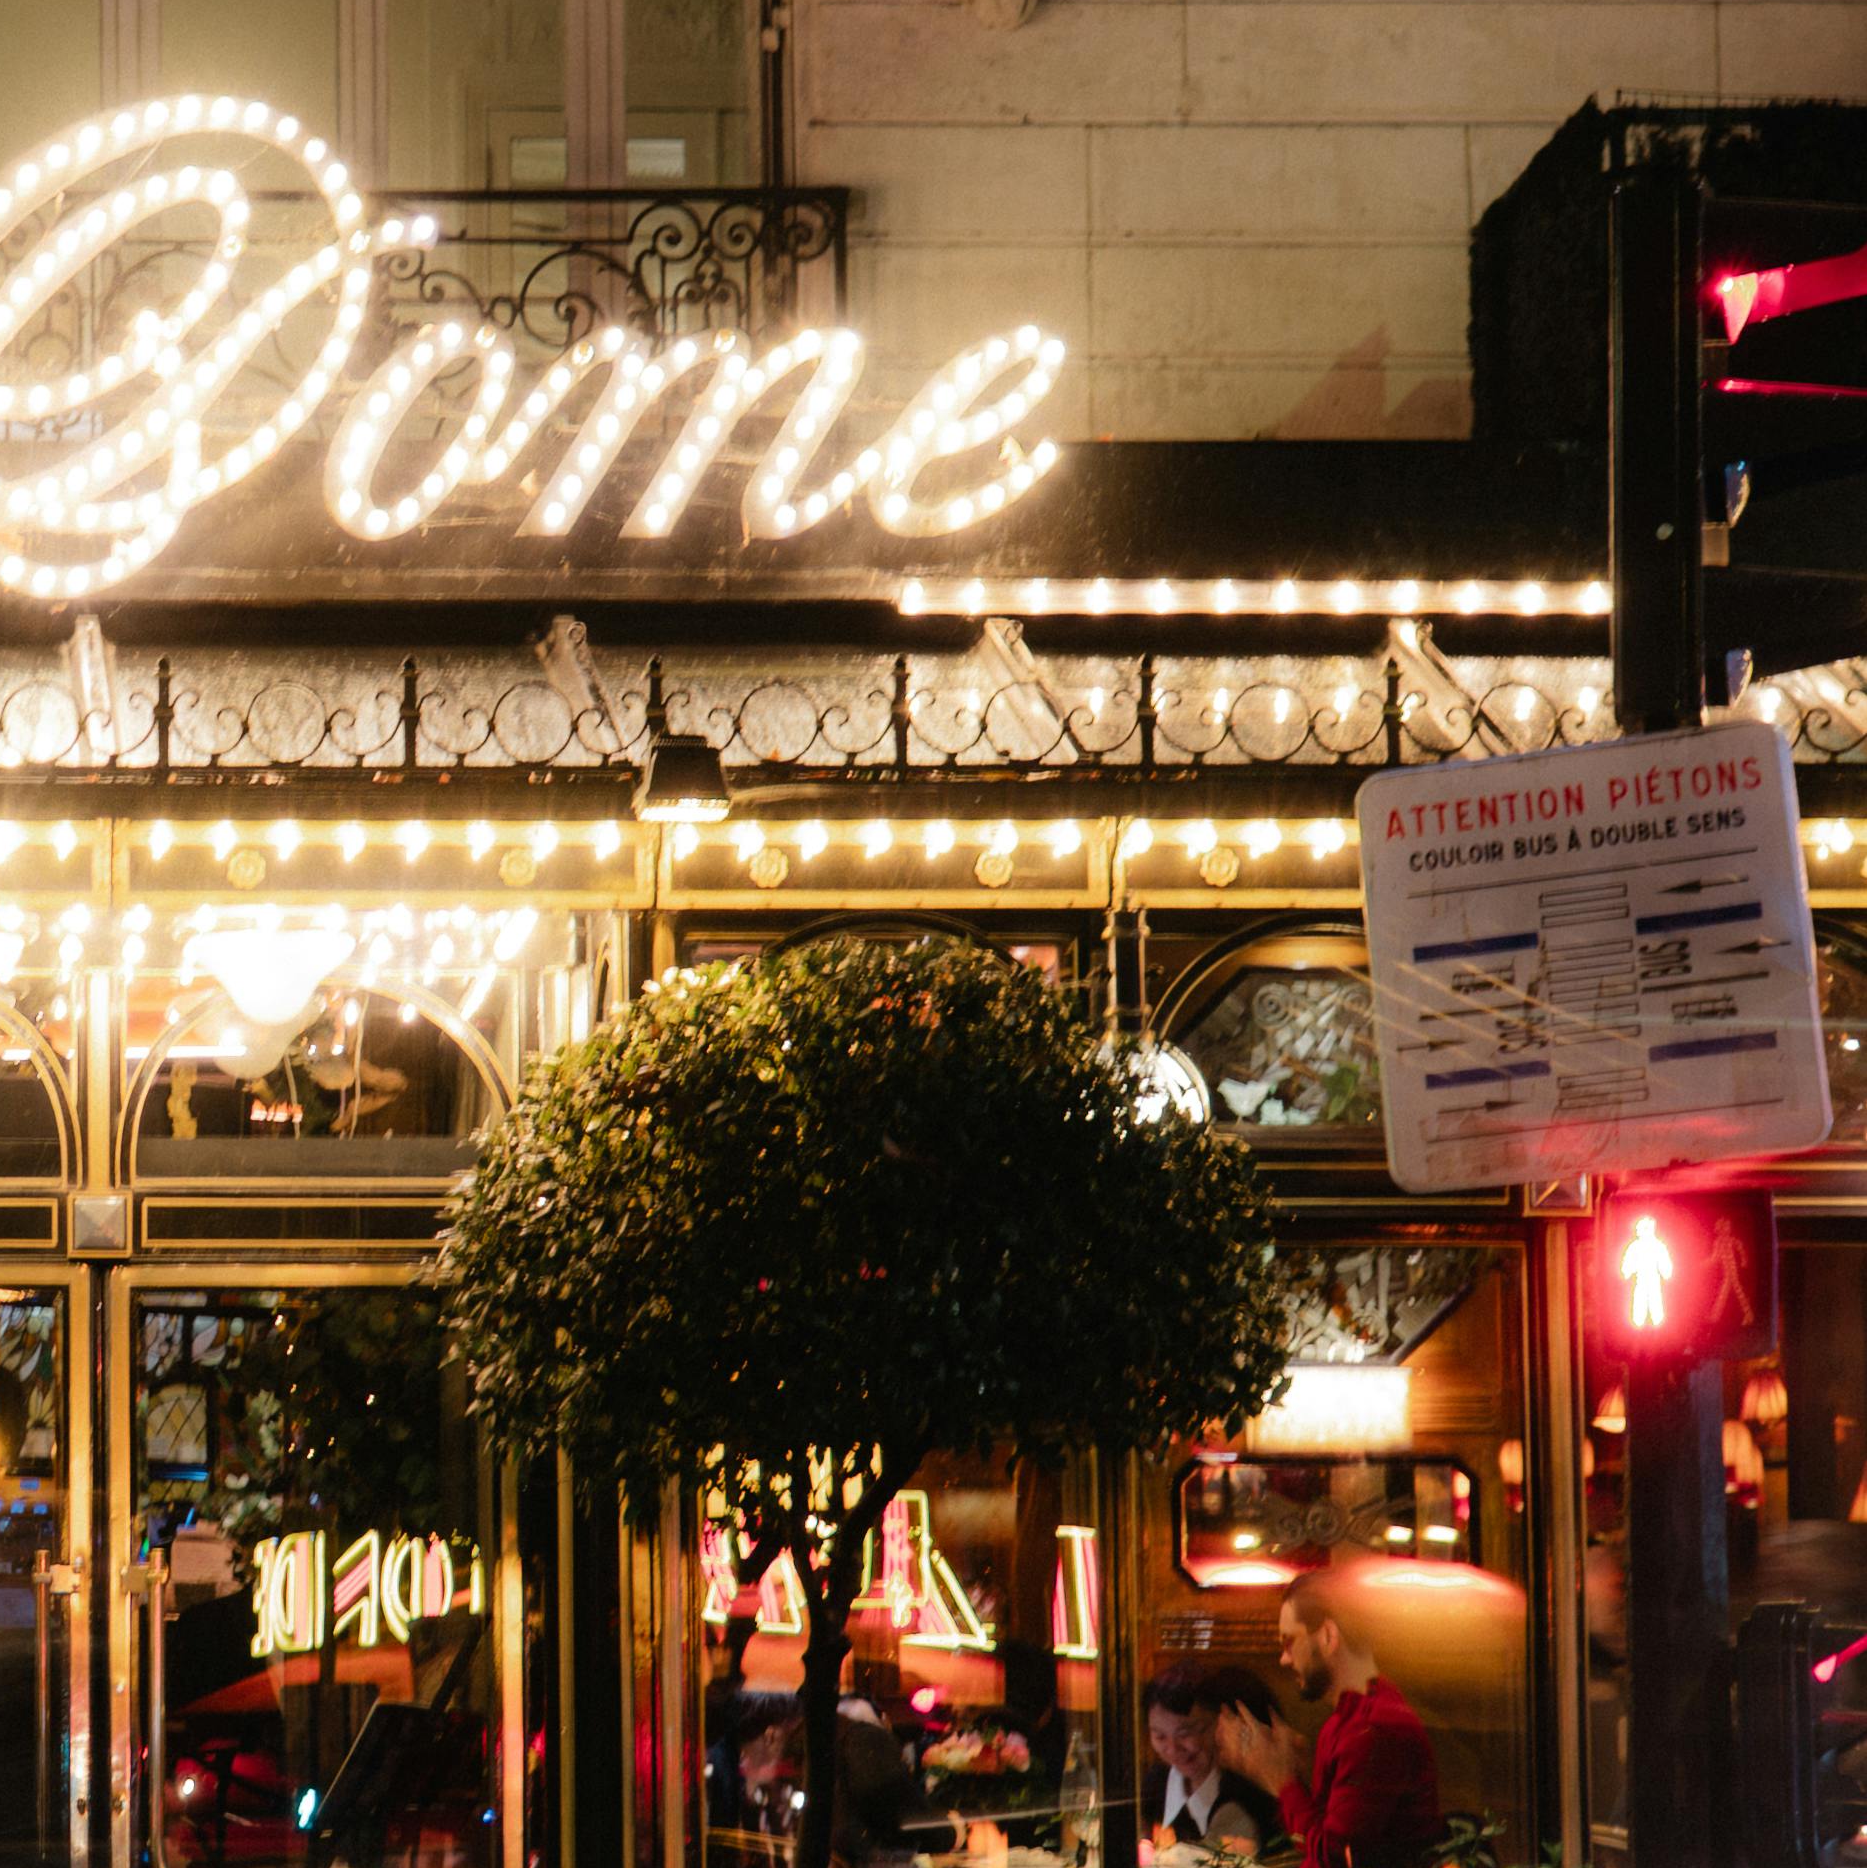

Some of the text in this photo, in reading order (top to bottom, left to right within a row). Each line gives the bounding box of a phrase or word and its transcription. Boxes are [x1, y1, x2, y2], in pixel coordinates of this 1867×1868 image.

[1386, 756, 1762, 841] ATTENTION PIÉTONS
[1409, 841, 1504, 872] COULOIR
[1514, 832, 1558, 859] BUS
[1590, 817, 1678, 848] DOUBLE
[1686, 806, 1746, 834] SENS
[1639, 940, 1692, 980] BUS
